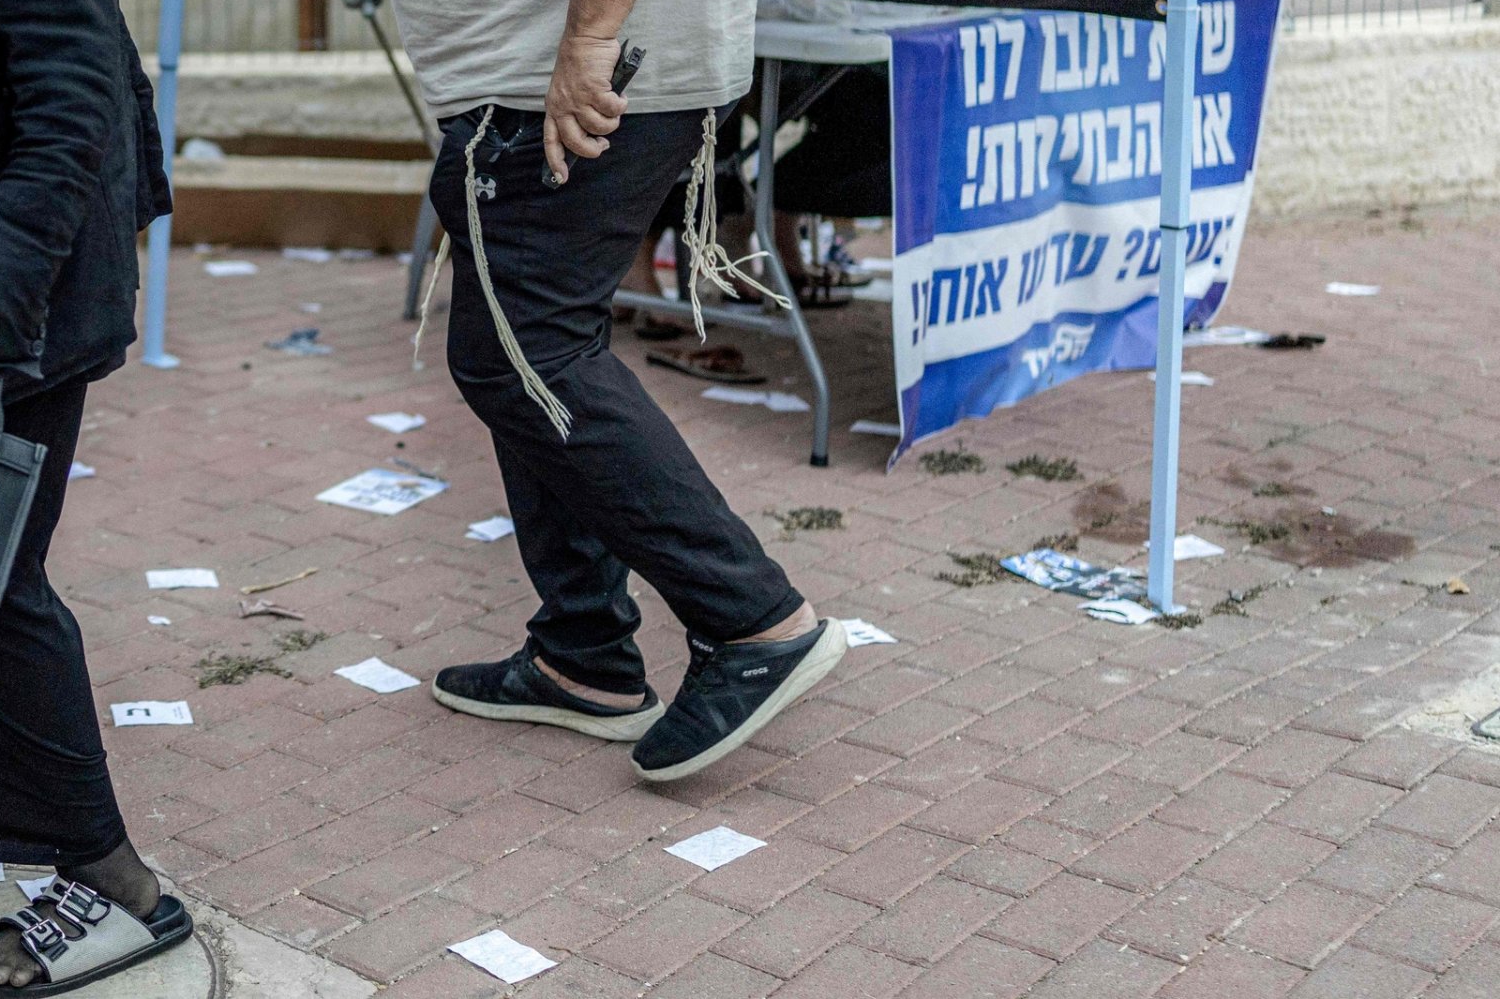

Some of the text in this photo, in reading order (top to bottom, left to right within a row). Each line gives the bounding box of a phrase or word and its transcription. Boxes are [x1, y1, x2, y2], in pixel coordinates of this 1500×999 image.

[959, 17, 1025, 108] לנו
[692, 639, 714, 653] crocs
[742, 666, 769, 677] crocs
